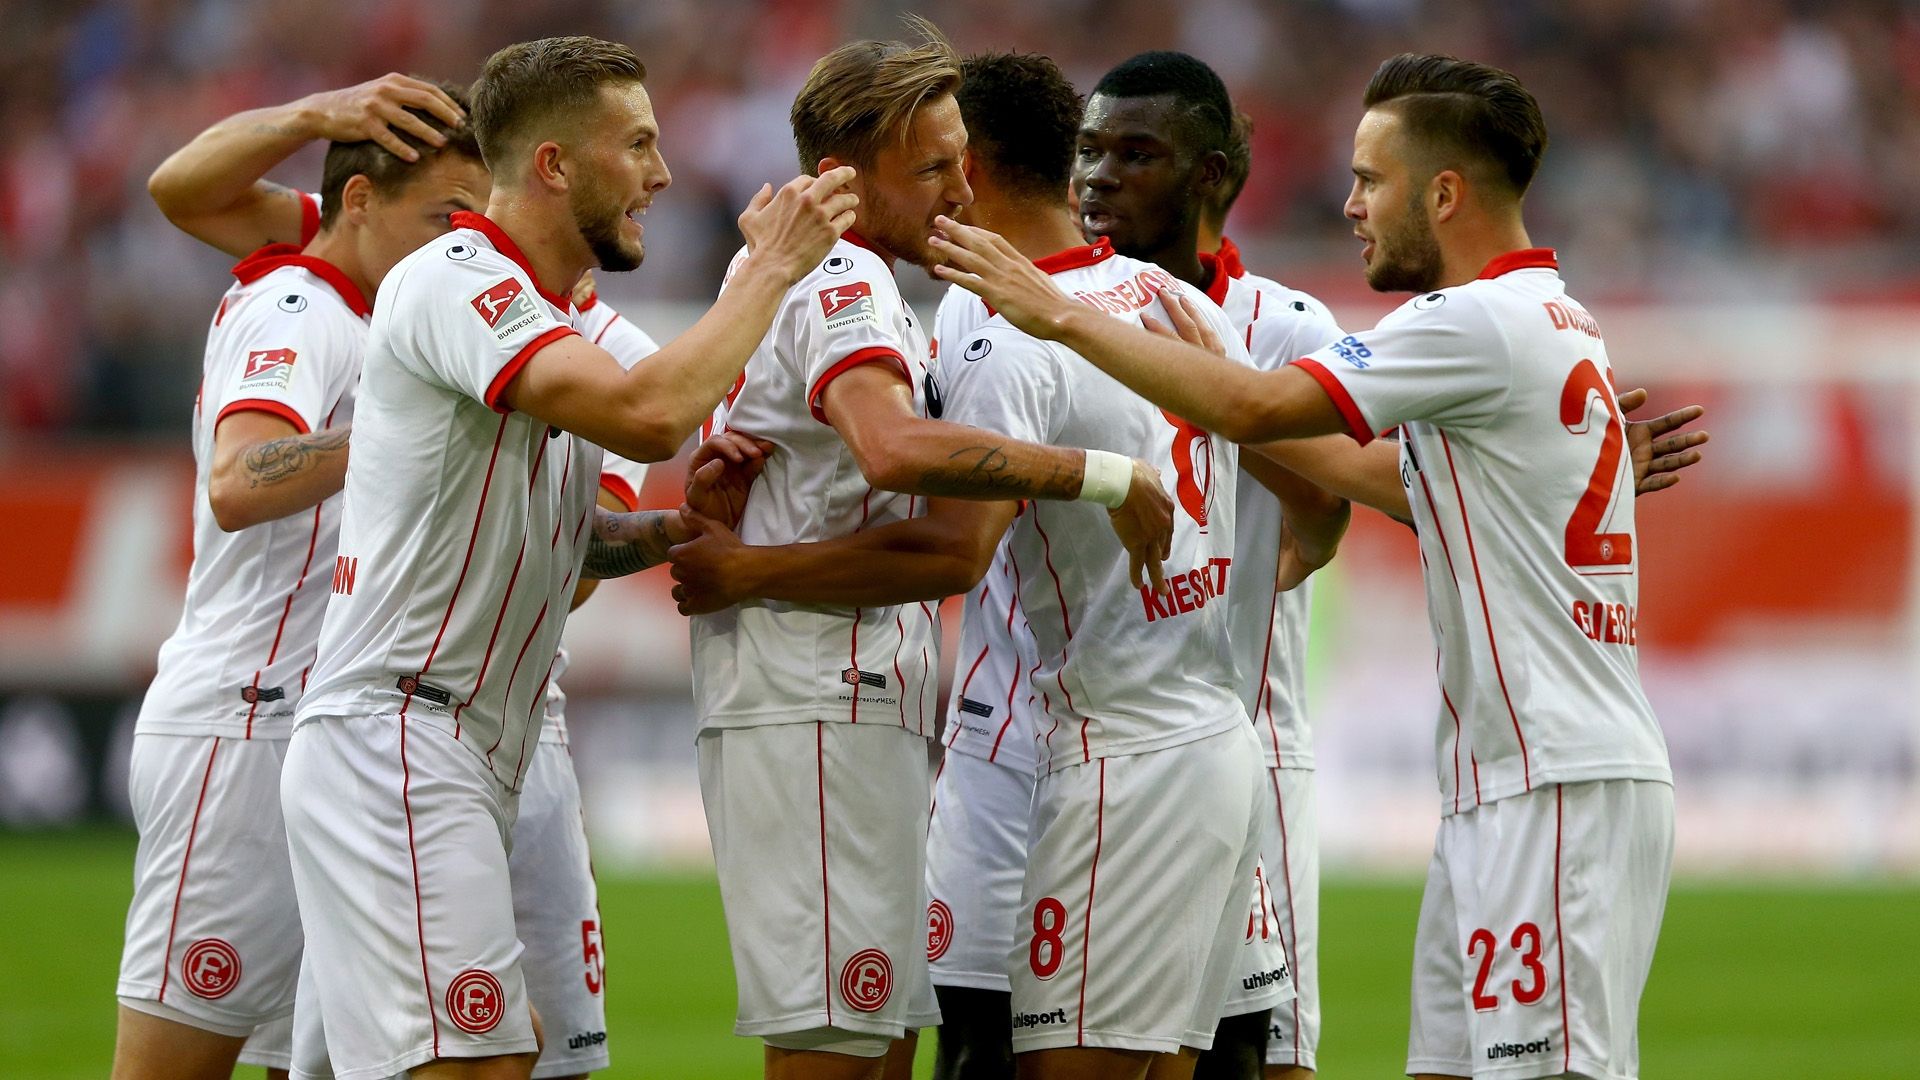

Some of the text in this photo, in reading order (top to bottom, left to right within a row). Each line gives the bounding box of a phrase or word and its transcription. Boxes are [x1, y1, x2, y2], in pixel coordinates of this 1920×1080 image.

[497, 312, 543, 341] BUNDESLIGA
[1030, 897, 1068, 981] 8
[1467, 922, 1549, 1014] 23
[1013, 1008, 1067, 1029] uhlsport
[1487, 1037, 1551, 1060] uhlsport
